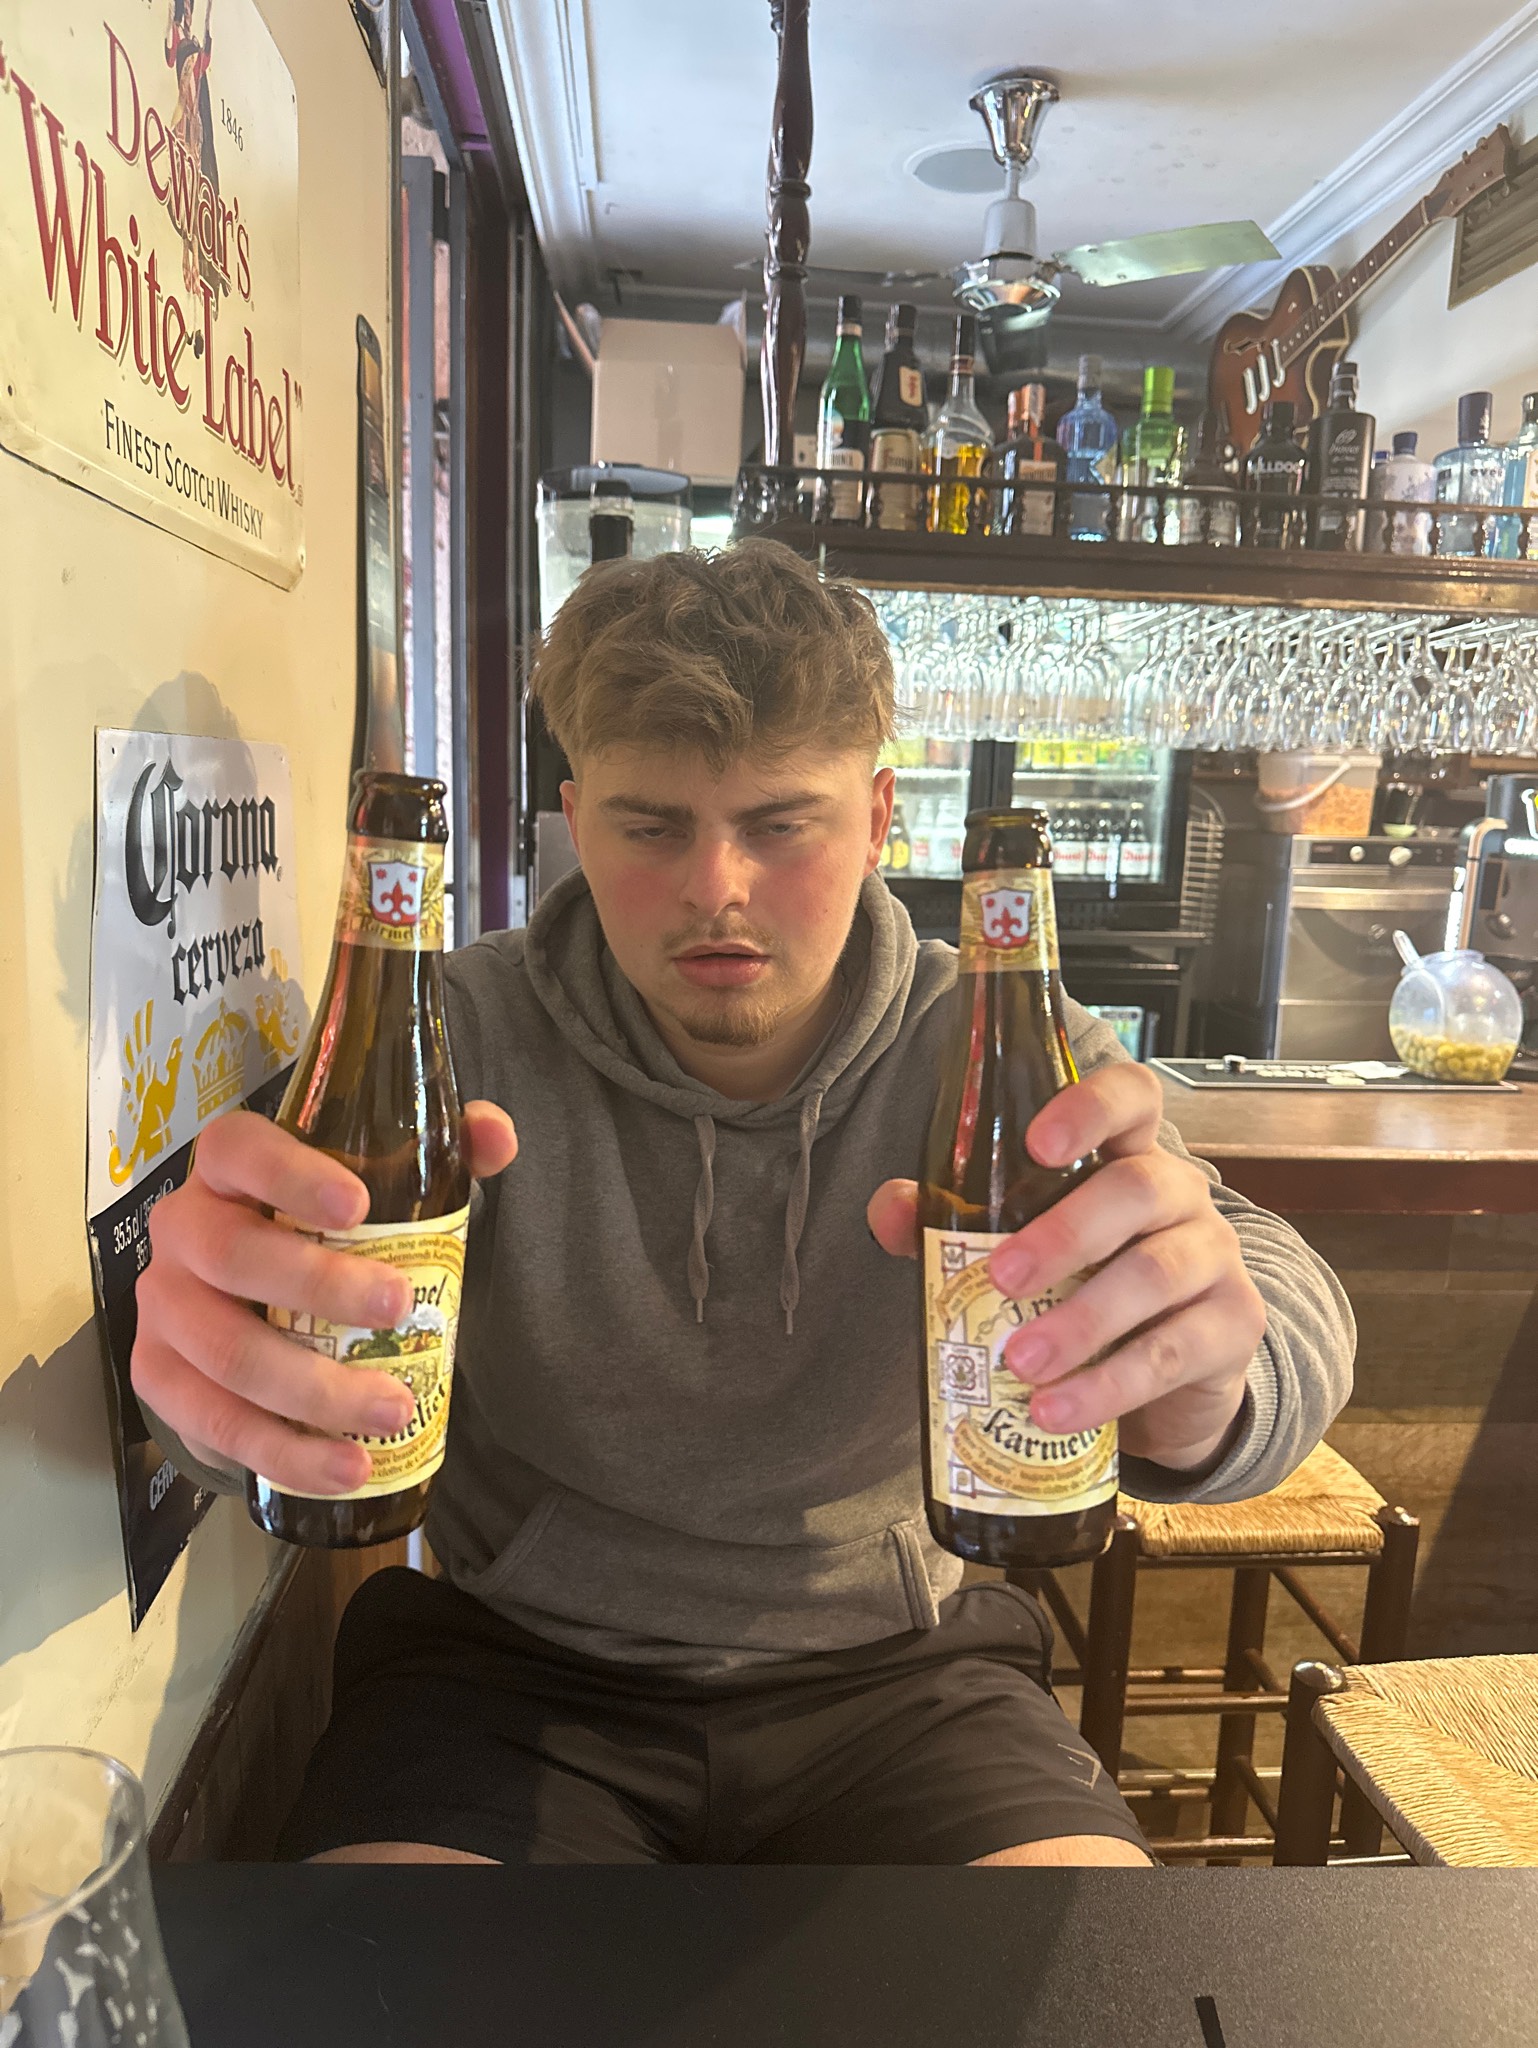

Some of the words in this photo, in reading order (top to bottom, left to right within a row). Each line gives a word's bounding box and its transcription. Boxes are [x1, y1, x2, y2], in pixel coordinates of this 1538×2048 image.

[104, 20, 251, 302] Dewar's
[220, 98, 245, 152] 1846
[103, 398, 162, 480] FINEST
[164, 441, 215, 513] SCOTCH
[216, 476, 264, 541] WHISKY
[125, 757, 279, 940] Corona
[113, 1215, 132, 1255] 35.5
[408, 1272, 448, 1314] pel
